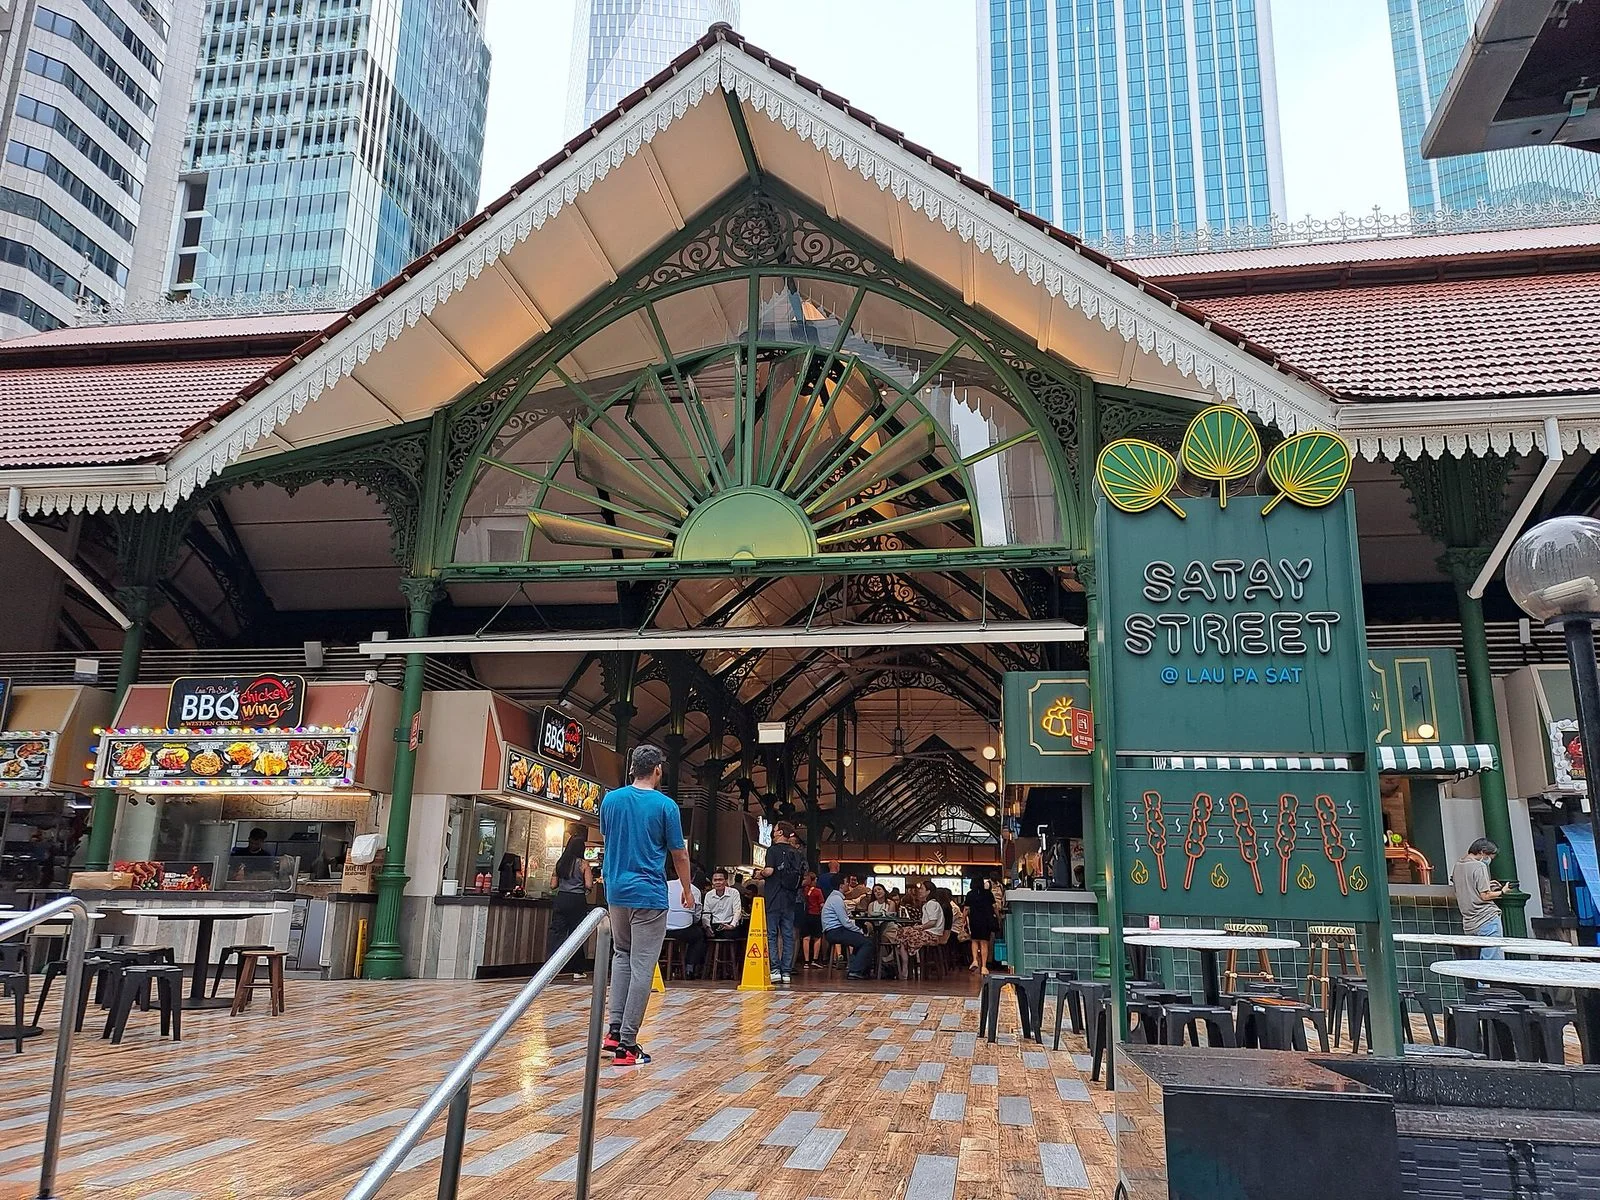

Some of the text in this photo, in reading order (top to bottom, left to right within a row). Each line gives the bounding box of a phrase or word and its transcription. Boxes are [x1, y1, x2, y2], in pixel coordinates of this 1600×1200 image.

[1142, 557, 1313, 602] SATAY
[1124, 611, 1341, 655] STREET
[1160, 666, 1303, 685] @ LAU PA SAT
[181, 689, 239, 720] BBQ
[240, 687, 289, 704] chicken
[242, 702, 280, 718] wing
[544, 722, 565, 753] BBQ
[892, 864, 919, 875] KOPI
[925, 865, 962, 876] KIOSK
